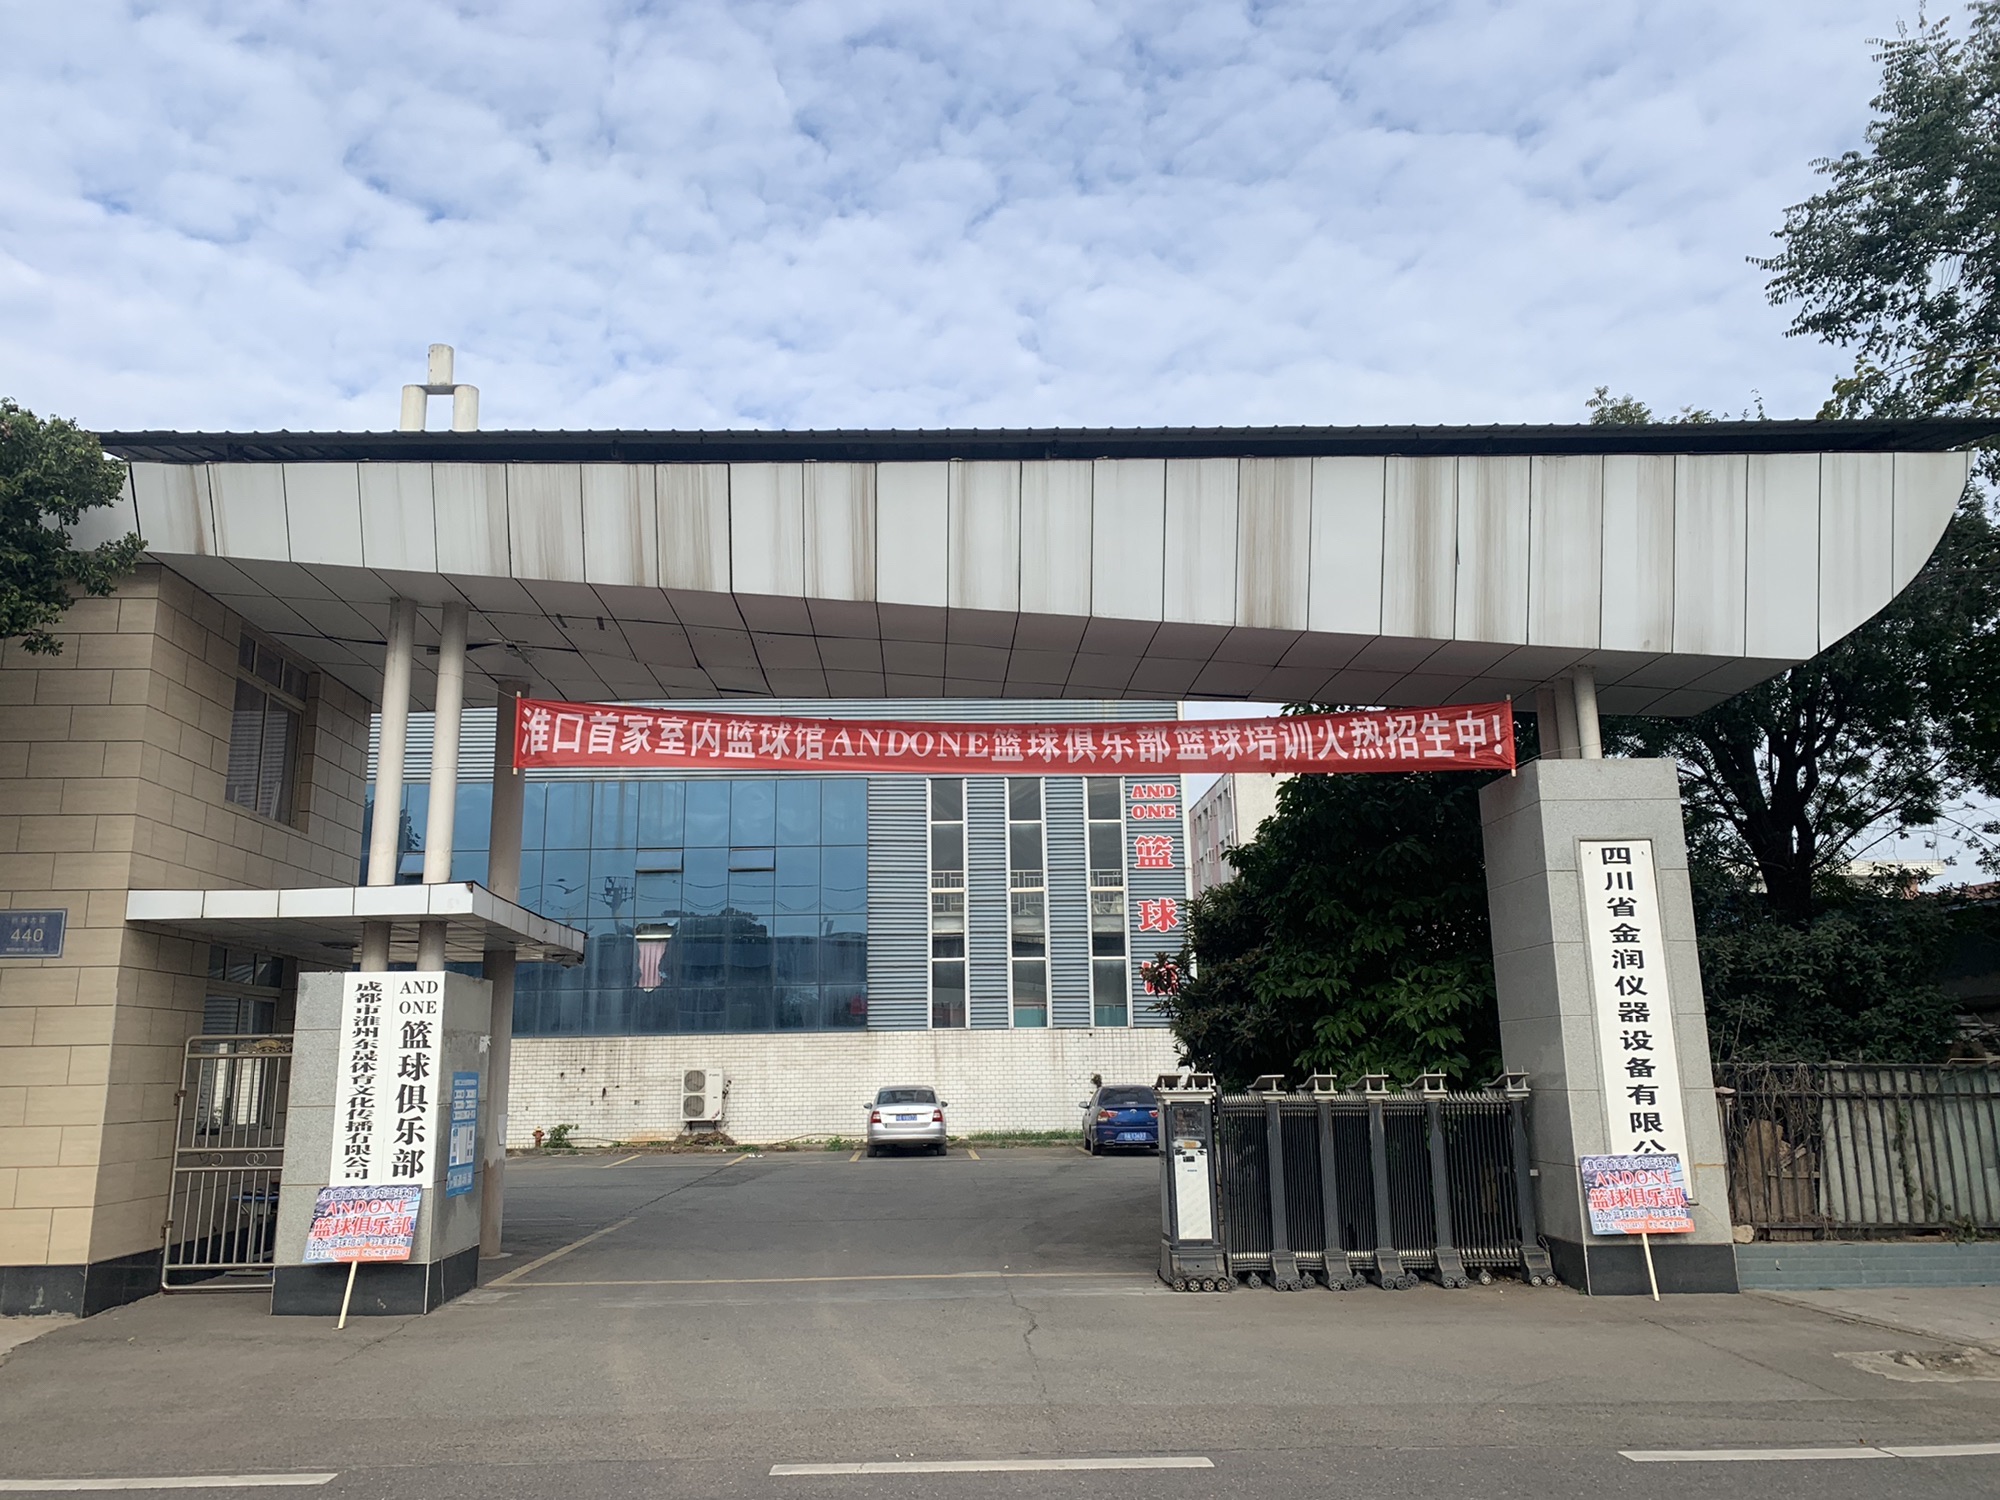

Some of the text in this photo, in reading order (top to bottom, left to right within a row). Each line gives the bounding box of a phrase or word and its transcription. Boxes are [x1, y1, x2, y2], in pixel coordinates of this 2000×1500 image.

[1131, 784, 1177, 799] AND
[1131, 803, 1177, 819] ONE
[10, 928, 44, 942] 440
[400, 980, 439, 995] AND
[399, 1000, 437, 1014] ONE
[391, 1020, 433, 1179] 篮球俱乐部
[1595, 1169, 1671, 1186] ANDONE
[1590, 1187, 1686, 1208] 篮球俱乐部
[324, 1199, 407, 1216] ANDONE
[313, 1216, 413, 1237] 篮球俱乐部
